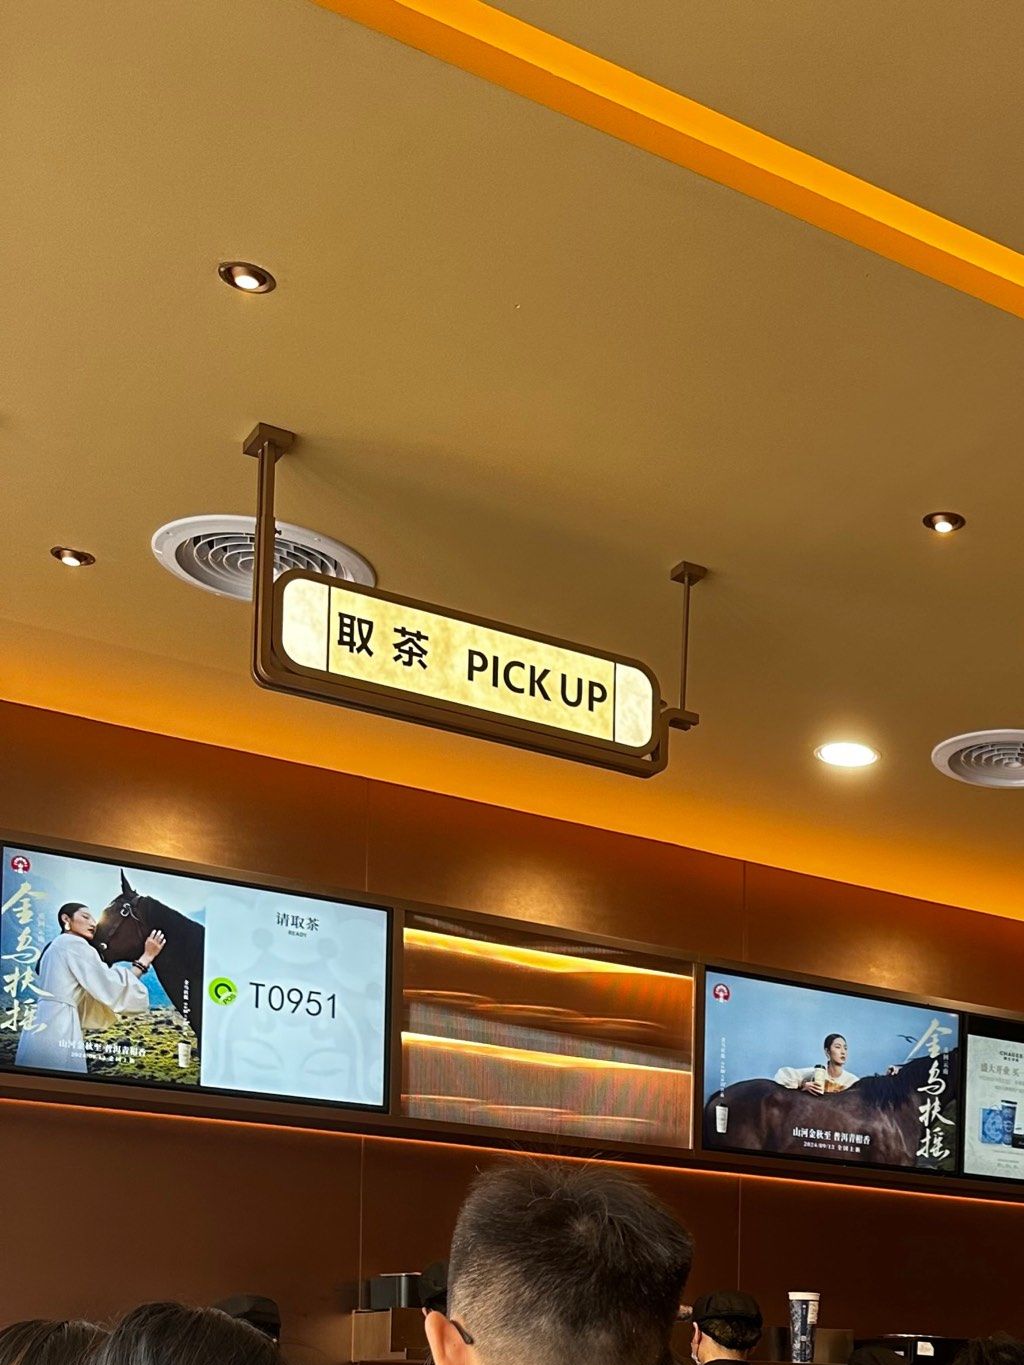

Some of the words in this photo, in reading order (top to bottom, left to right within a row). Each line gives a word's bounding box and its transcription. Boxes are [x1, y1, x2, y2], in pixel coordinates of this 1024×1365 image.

[338, 612, 429, 669] 取茶
[467, 649, 552, 702] PICK
[560, 673, 608, 712] UP
[276, 911, 320, 931] 请取茶
[249, 982, 336, 1019] T0951
